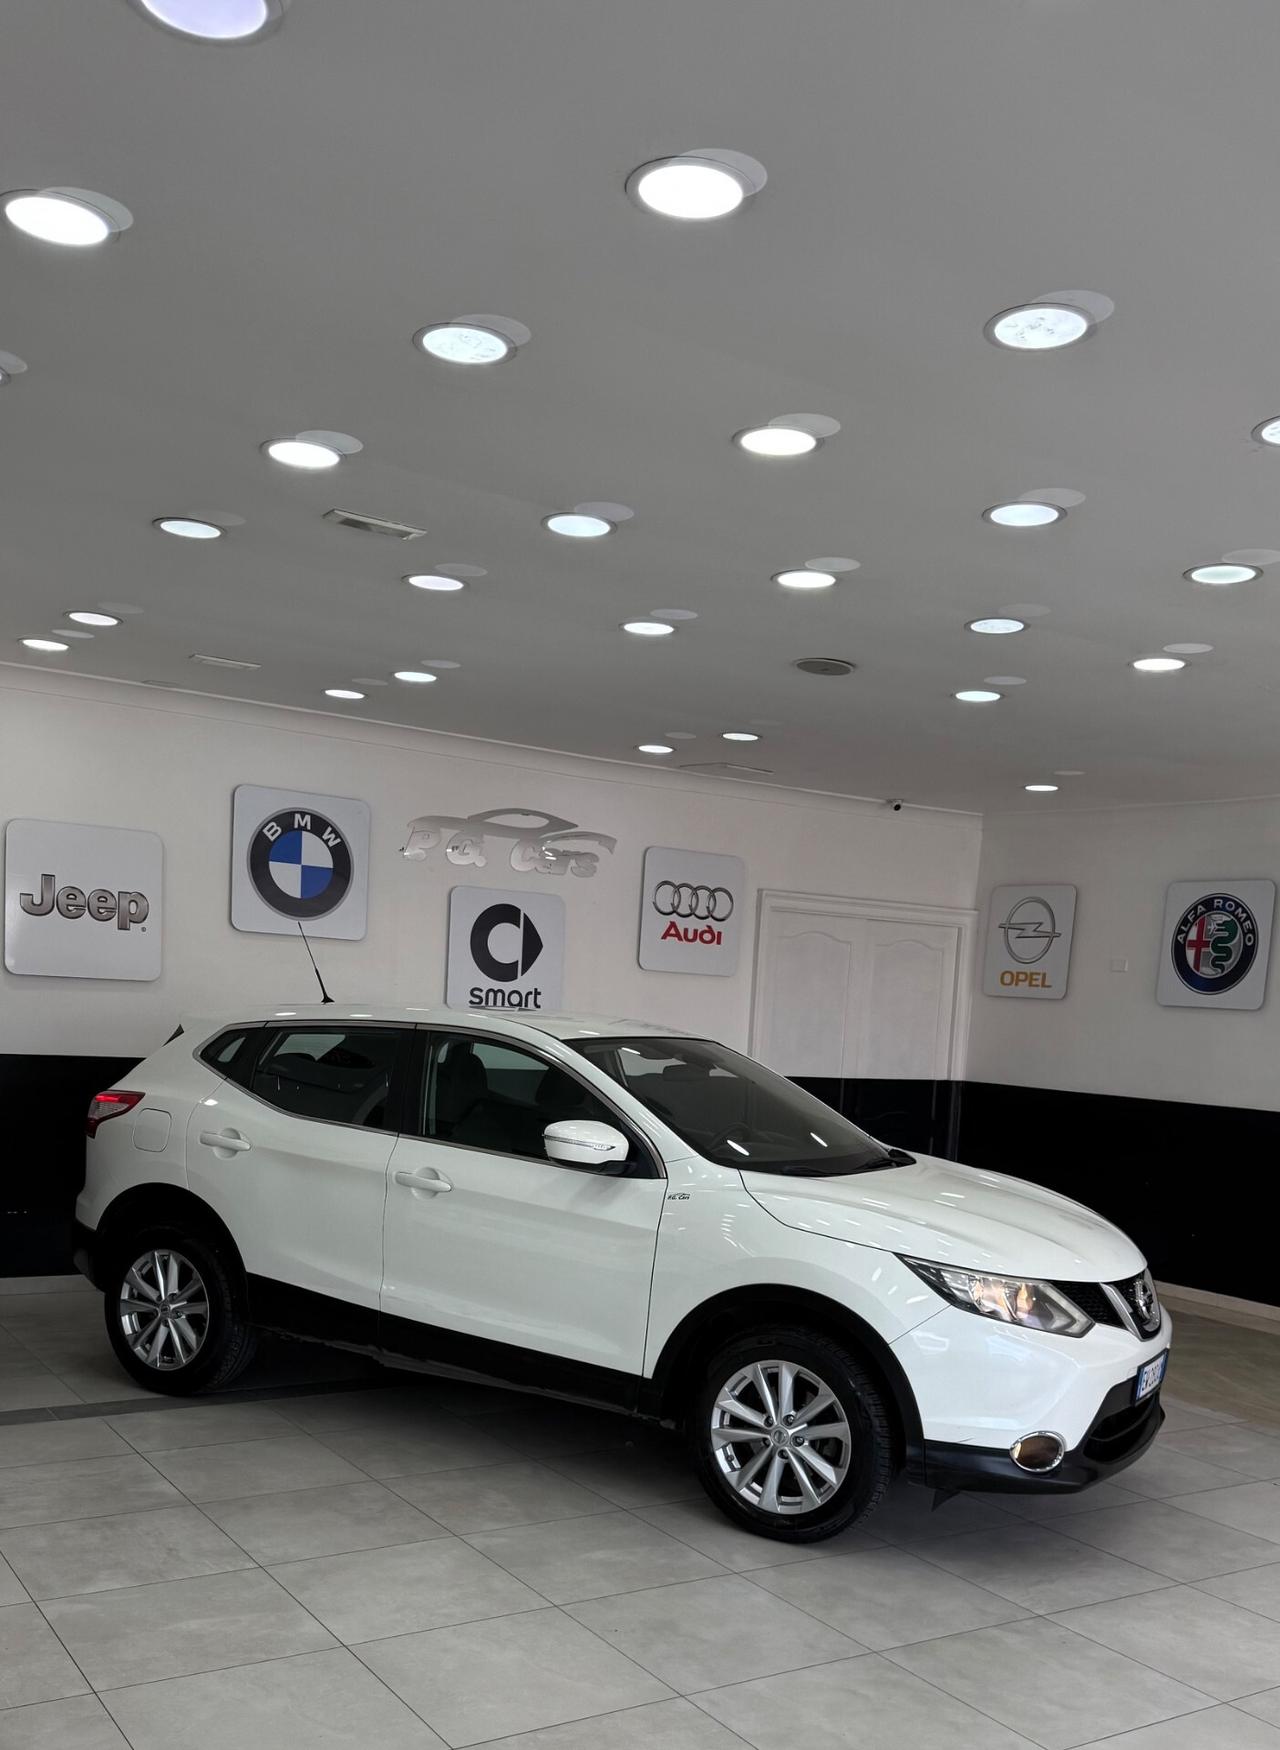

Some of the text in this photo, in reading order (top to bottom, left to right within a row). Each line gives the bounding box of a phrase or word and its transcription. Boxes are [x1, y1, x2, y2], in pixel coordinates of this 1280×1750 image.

[262, 813, 341, 848] BMW
[20, 873, 150, 931] Jeep
[661, 920, 723, 946] Audi
[1177, 899, 1254, 947] ALFA ROMEO
[1000, 970, 1053, 988] OPEL
[468, 987, 542, 1009] smart
